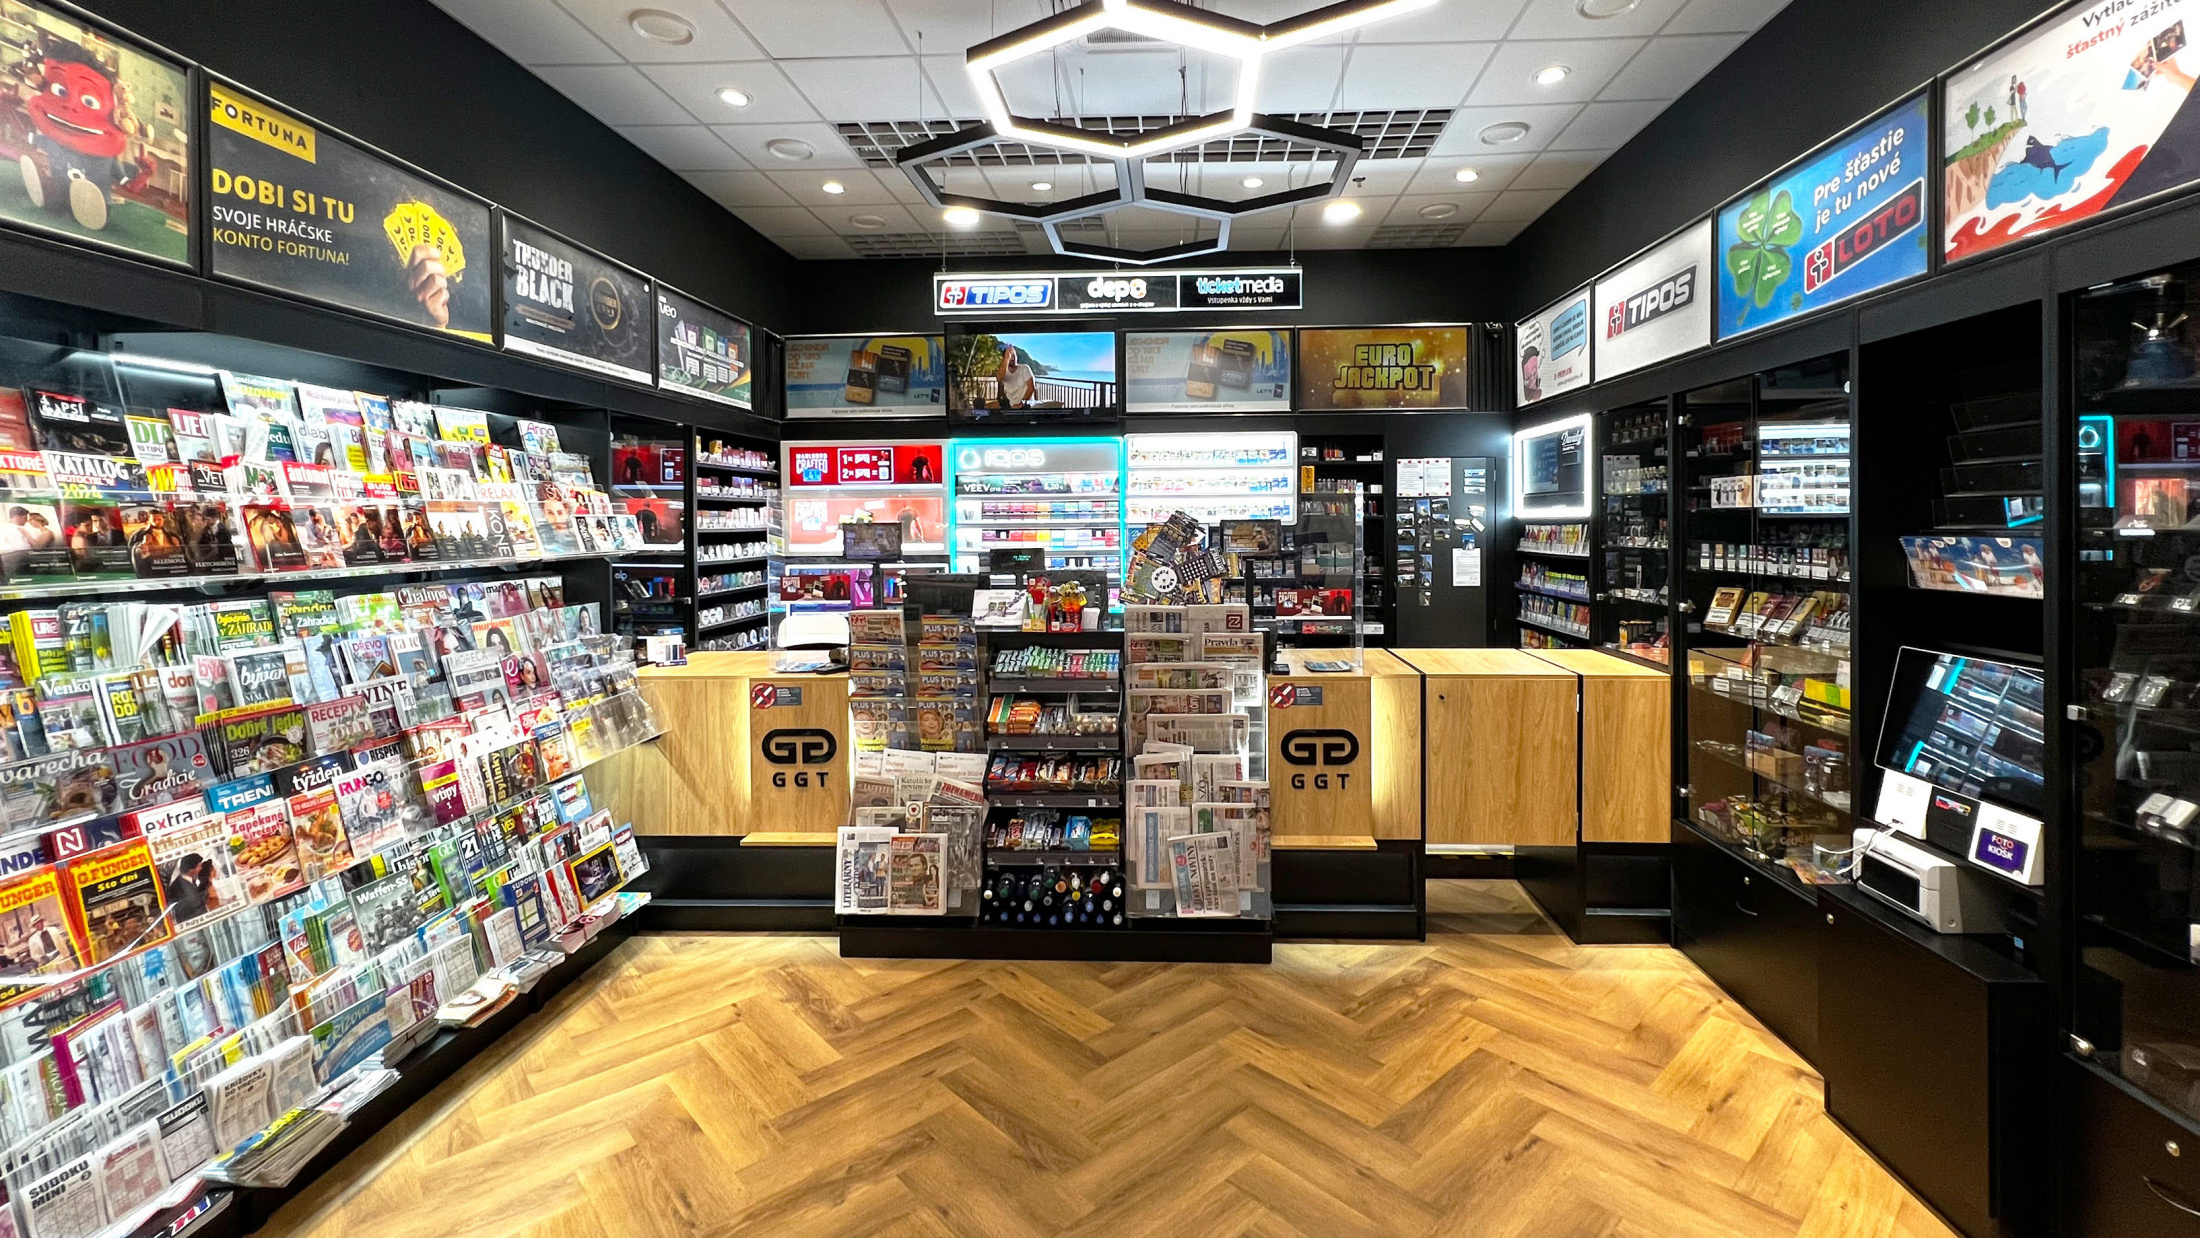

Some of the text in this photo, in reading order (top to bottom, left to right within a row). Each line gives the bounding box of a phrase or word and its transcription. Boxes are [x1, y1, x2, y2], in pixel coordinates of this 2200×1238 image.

[2067, 17, 2125, 59] šťastný
[212, 96, 307, 150] FORTUNA
[1813, 127, 1904, 207] Pre šťastie
[212, 168, 354, 223] DOBI SI TU
[1814, 208, 1831, 234] je
[1835, 192, 1852, 216] tu
[1857, 151, 1901, 200] nové
[213, 205, 332, 243] SVOJE HRÁČSKE
[1838, 194, 1917, 263] LOTO
[213, 227, 349, 265] KONTO FORTUNA!
[516, 264, 574, 313] BLACK
[970, 285, 1045, 304] TIPOS
[1087, 276, 1147, 302] depo
[1196, 276, 1284, 294] ticketmedia
[1629, 272, 1691, 324] TIPOS
[1356, 344, 1413, 367] EURO
[1333, 365, 1435, 390] JACKPOT
[527, 422, 555, 438] Anna
[51, 455, 129, 481] KATALOG
[984, 449, 1046, 468] IQOS
[480, 487, 517, 499] RELAX
[963, 483, 990, 492] VEEV
[486, 508, 514, 557] KONE
[1204, 638, 1238, 646] Pravda
[311, 702, 364, 723] RECEPTY
[231, 746, 250, 758] 326
[119, 768, 197, 800] Tradície
[292, 763, 343, 792] týždeň
[432, 784, 457, 803] vtipy
[145, 811, 193, 834] extra
[55, 827, 83, 856] N
[462, 838, 481, 858] 21
[1987, 844, 2013, 861] KIOSK
[1991, 834, 2014, 849] FOTO
[98, 880, 117, 893] Sto
[356, 874, 409, 905] Waffen-SS
[511, 872, 537, 890] SUDOKU
[162, 1095, 203, 1124] SUDOKU
[28, 1160, 89, 1199] SUDOKU
[32, 1184, 66, 1209] MINI
